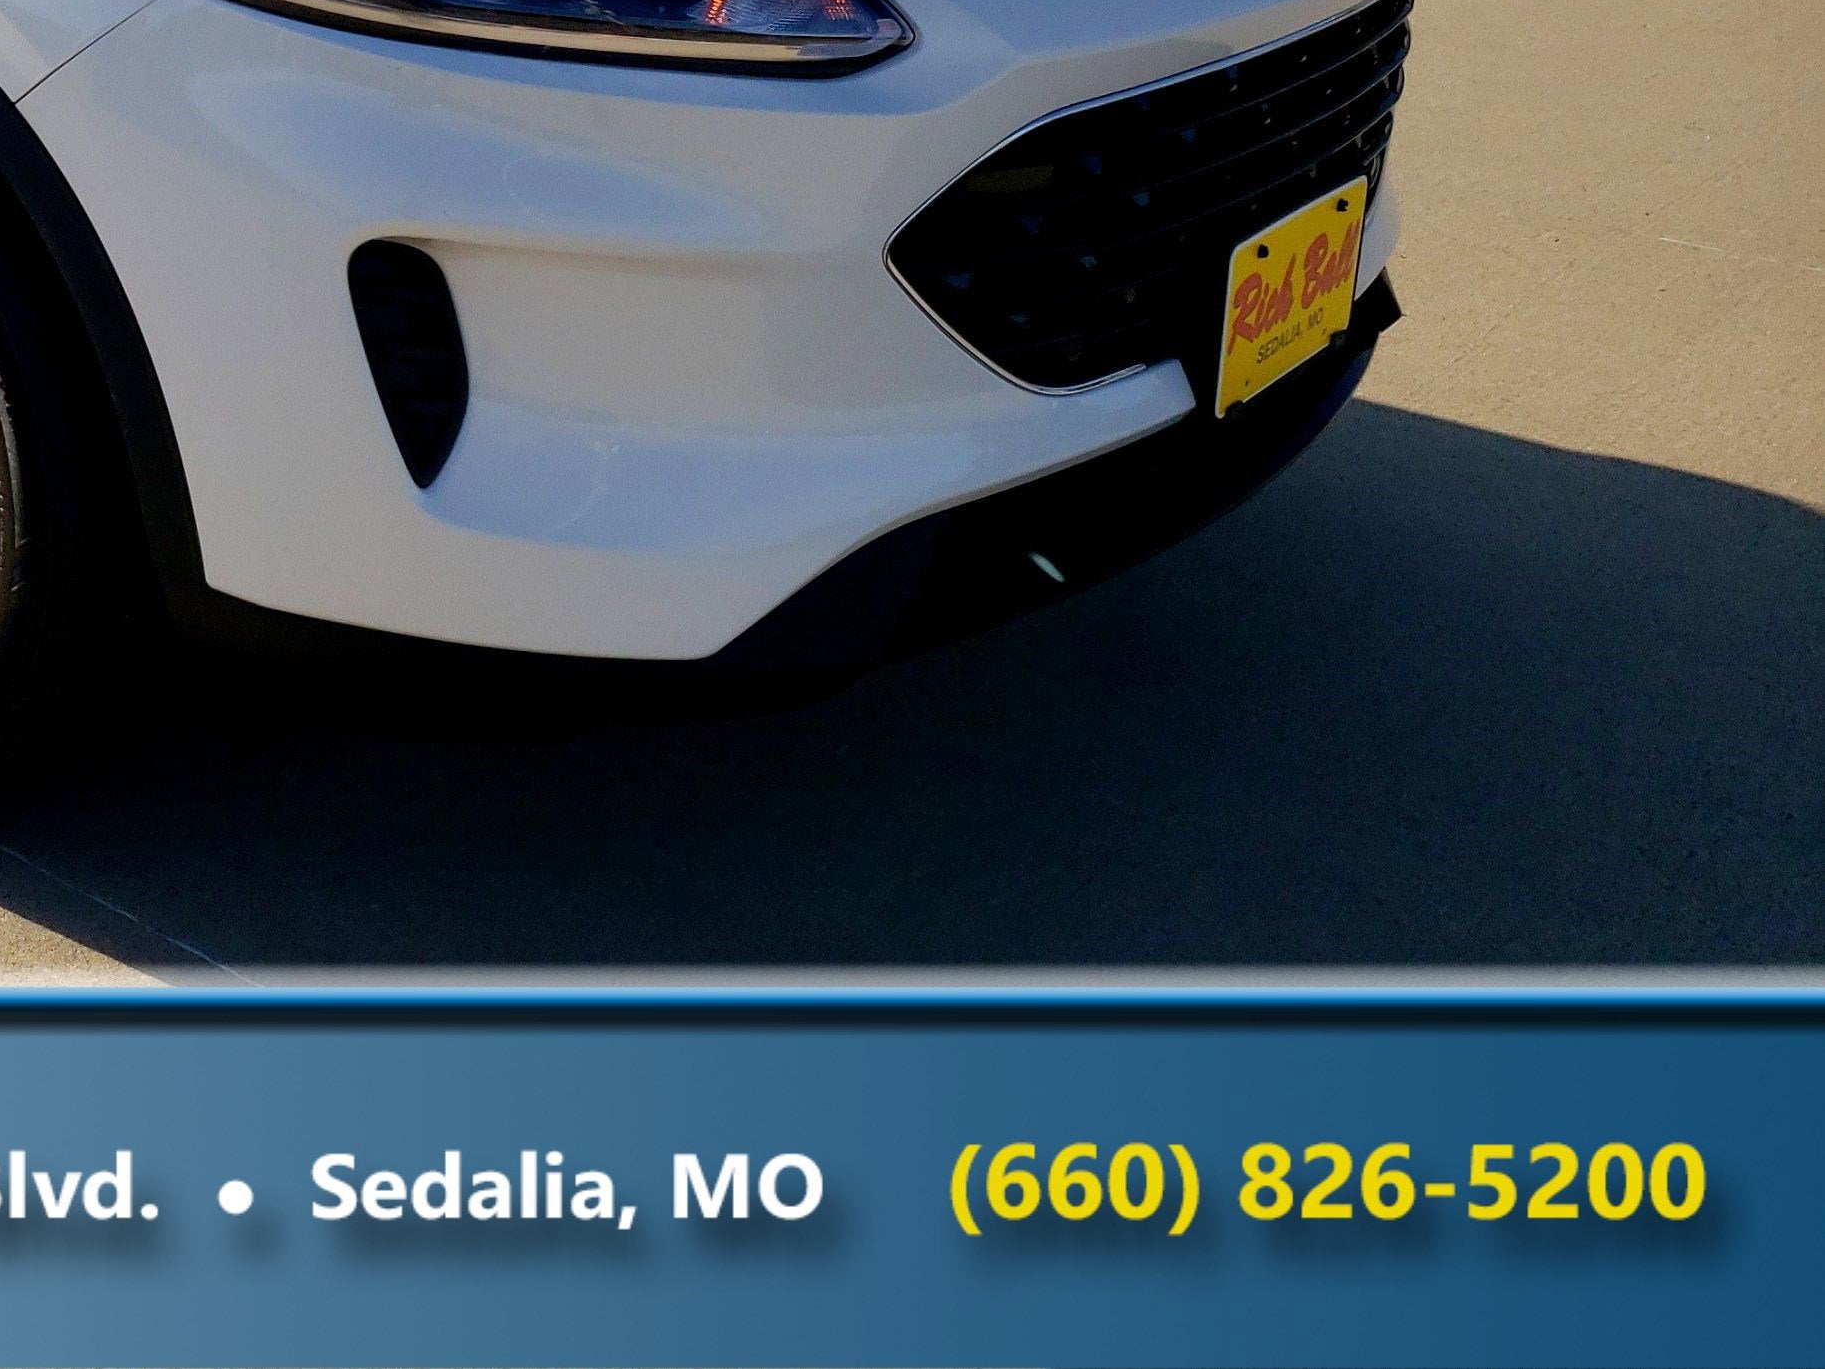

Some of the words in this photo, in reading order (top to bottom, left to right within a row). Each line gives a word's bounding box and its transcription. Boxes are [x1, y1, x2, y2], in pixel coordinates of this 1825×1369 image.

[1226, 253, 1297, 357] Rick
[1300, 218, 1362, 310] Ball
[1256, 320, 1304, 365] SEDALIA,
[1307, 306, 1324, 332] MO
